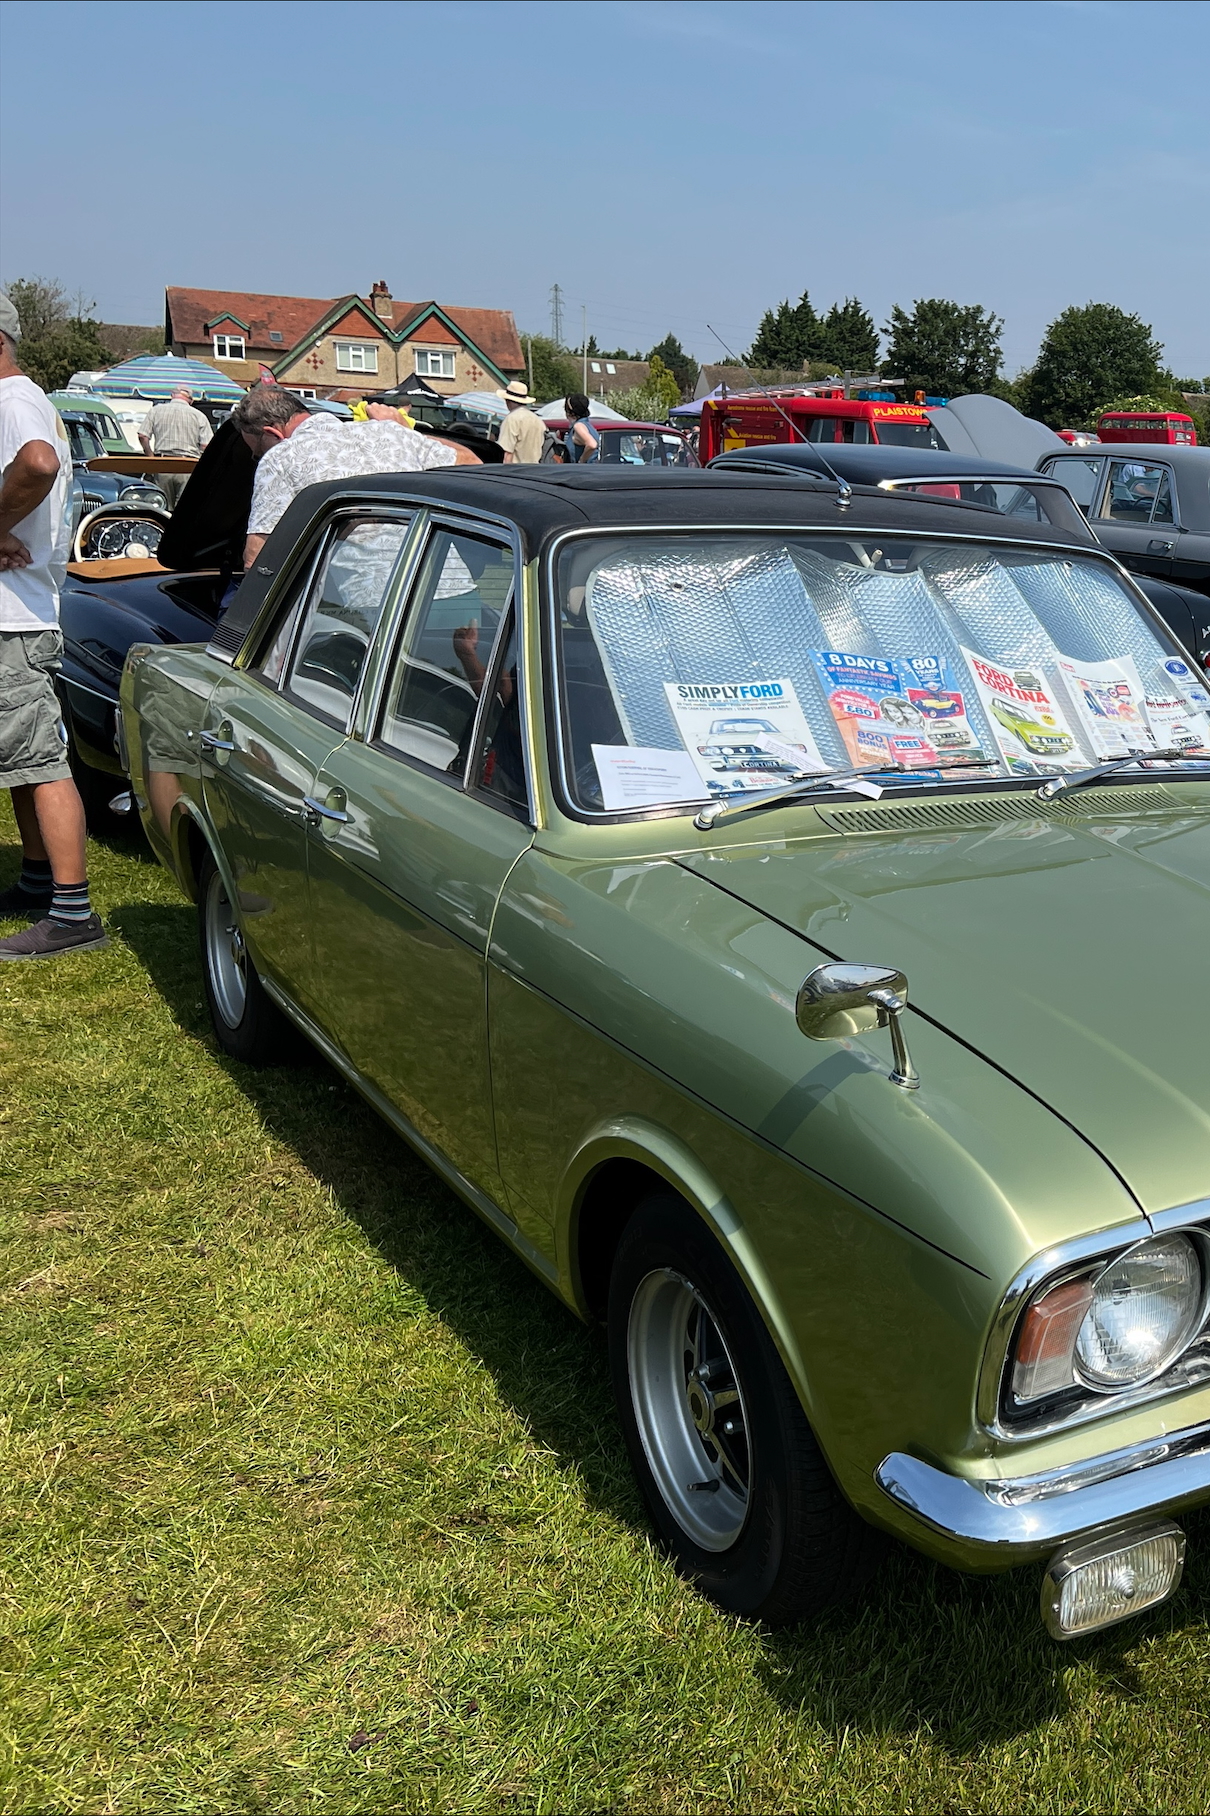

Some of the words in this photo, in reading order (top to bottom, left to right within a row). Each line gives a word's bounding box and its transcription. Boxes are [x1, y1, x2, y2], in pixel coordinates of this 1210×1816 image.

[828, 653, 842, 666] 8
[843, 655, 889, 672] DAYS
[911, 657, 937, 670] 80
[972, 658, 1014, 688] FORD
[677, 683, 784, 699] SIMPLYFORD
[978, 671, 1050, 704] CORTINA
[846, 705, 872, 717] £80
[857, 730, 883, 743] 800
[857, 738, 888, 750] BONUS
[894, 740, 920, 748] FREE
